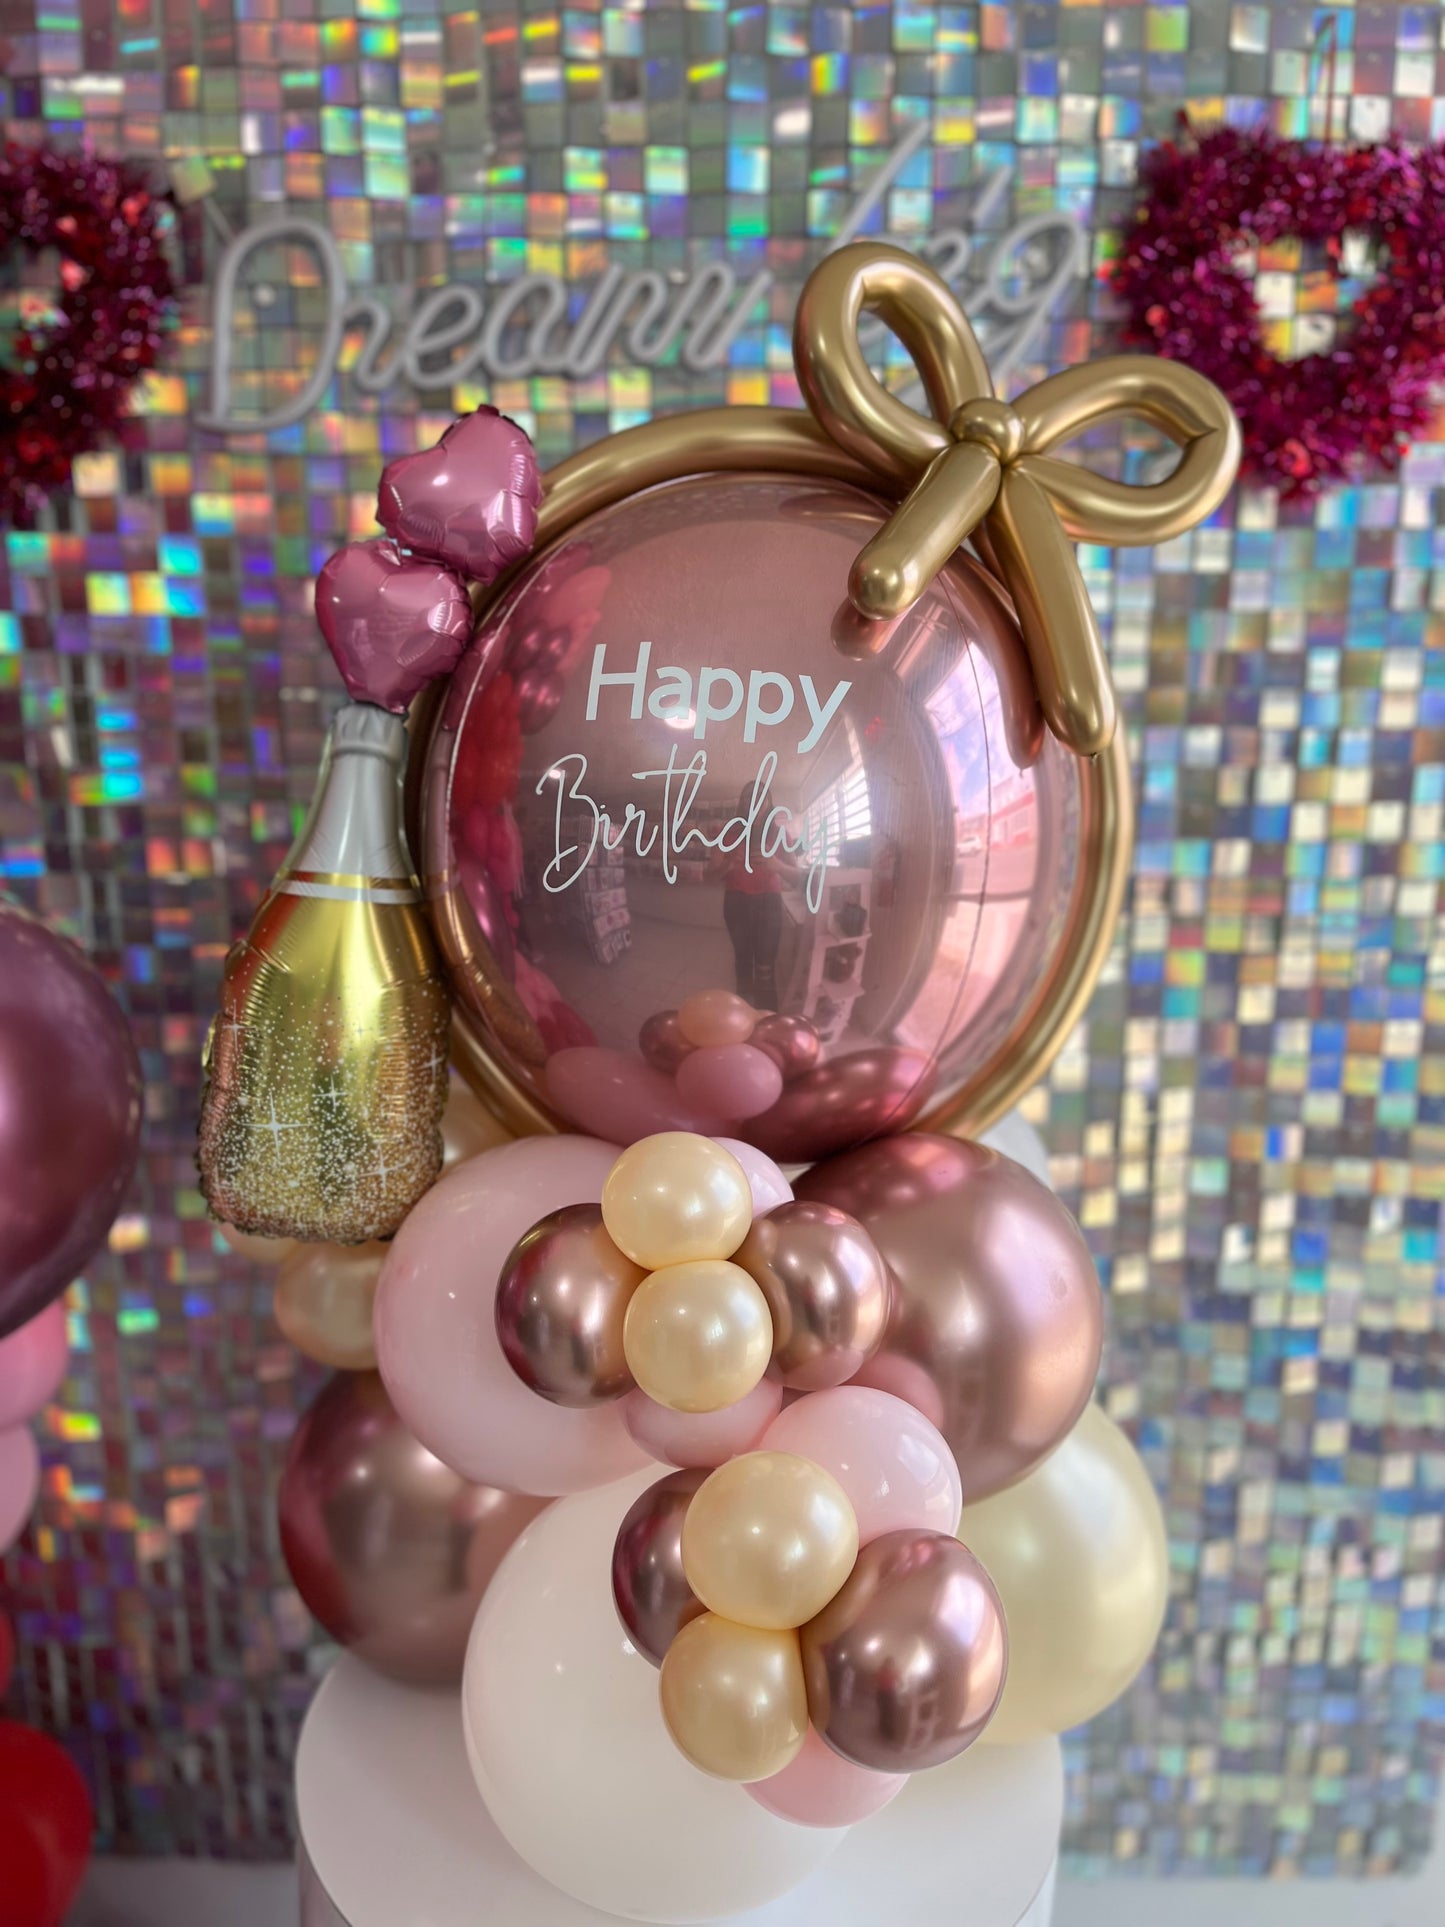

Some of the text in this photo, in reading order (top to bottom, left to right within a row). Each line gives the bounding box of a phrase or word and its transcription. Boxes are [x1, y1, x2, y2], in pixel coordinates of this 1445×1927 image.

[195, 216, 775, 432] Dream
[585, 641, 852, 754] Happy
[535, 743, 851, 914] Birthday
